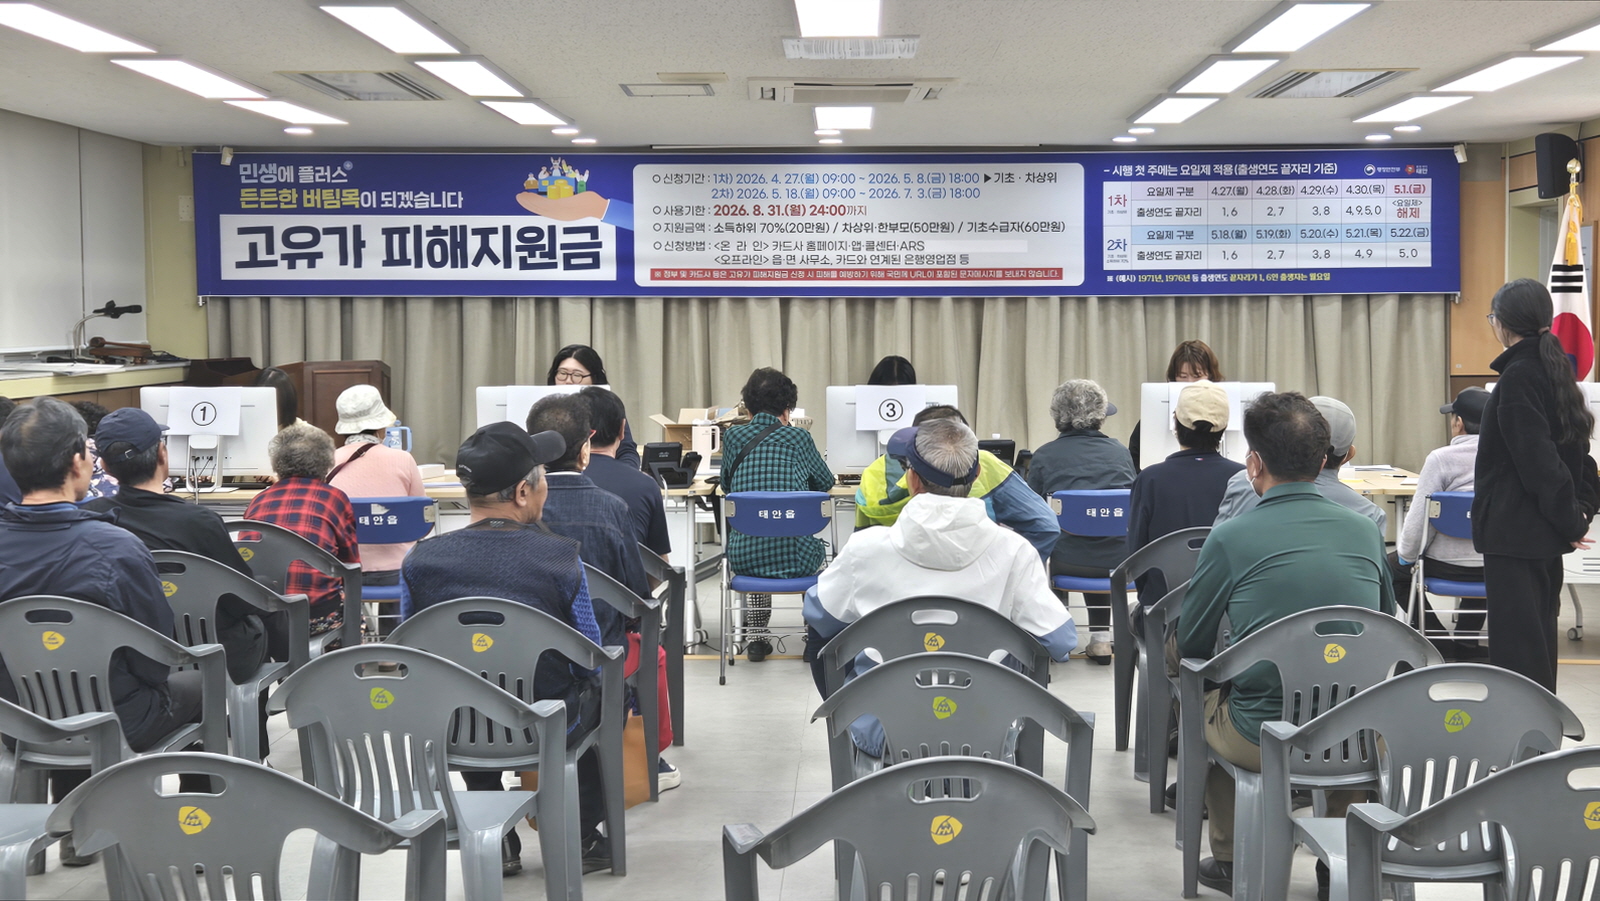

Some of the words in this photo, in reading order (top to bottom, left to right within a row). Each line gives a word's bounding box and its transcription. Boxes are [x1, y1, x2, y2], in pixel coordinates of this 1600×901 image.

[239, 163, 294, 184] 민생에
[298, 166, 348, 184] 플러스
[1112, 164, 1132, 176] 시행
[1135, 164, 1145, 176] 첫
[1148, 164, 1178, 176] 주에는
[1180, 164, 1210, 176] 요일제
[1280, 163, 1311, 175] 끝자리
[1314, 162, 1338, 175] 기준)
[663, 173, 705, 184] 신청기간
[713, 173, 733, 184] 1차)
[736, 173, 768, 184] 2026.
[772, 173, 782, 184] 4.
[784, 173, 820, 184] 27.(월)
[822, 173, 856, 184] 09:00
[868, 173, 900, 184] 2026.
[904, 173, 914, 184] 5.
[917, 173, 946, 184] 8.(금)
[950, 173, 980, 184] 18:00
[1025, 172, 1057, 184] 차상위
[712, 188, 734, 199] 2차)
[738, 188, 769, 199] 2026.
[772, 188, 782, 199] 5.
[786, 188, 820, 199] 18.(월)
[822, 188, 856, 199] 09:00
[868, 188, 901, 199] 2026.
[904, 188, 912, 199] 7.
[918, 188, 946, 199] 3.(금)
[950, 188, 980, 199] 18:00
[1147, 187, 1174, 196] 요일제
[1176, 187, 1194, 196] 구분
[1211, 186, 1248, 196] 4.27.(월)
[1256, 186, 1296, 196] 4.28.(화)
[1300, 185, 1338, 196] 4.29.(수)
[1346, 184, 1385, 195] 4.30.(목)
[1394, 184, 1426, 194] 5.1.(금)
[240, 188, 298, 209] 든든한
[303, 188, 376, 209] 버팀목이
[381, 190, 463, 208] 되겠습니다
[1108, 194, 1128, 208] 1차
[664, 206, 706, 216] 사용기한
[714, 204, 749, 216] 2026.
[752, 204, 764, 216] 8.
[767, 204, 806, 216] 31.(월)
[810, 204, 868, 216] 24:00까지
[1136, 207, 1172, 217] 출생연도
[1175, 207, 1202, 217] 끝자리
[1396, 208, 1420, 218] 해제
[664, 222, 706, 234] 지원금액
[714, 222, 757, 234] 소득하위
[760, 222, 830, 234] 70%(20만원)
[842, 222, 954, 234] 차상위·한부모(50만원)
[966, 222, 1066, 234] 기초수급자(60만원)
[1300, 228, 1339, 239] 5.20.(수)
[1346, 228, 1382, 238] 5.21.(목)
[1390, 228, 1429, 238] 5.22.(금)
[1147, 230, 1174, 240] 요일제
[1176, 230, 1194, 240] 구분
[1212, 230, 1248, 240] 5.18.(월)
[1256, 229, 1292, 240] 5.19.(화)
[235, 224, 366, 270] 고유가
[382, 224, 602, 270] 피해지원금
[664, 240, 706, 252] 신청방법
[772, 240, 803, 252] 카드사
[1107, 238, 1128, 252] 2차
[714, 254, 769, 265] <오프라인>
[772, 254, 796, 265] 읍·면
[836, 254, 867, 265] 카드와
[870, 254, 902, 265] 연계된
[904, 254, 957, 265] 은행영업점
[960, 254, 970, 265] 등
[1136, 251, 1172, 260] 출생연도
[1175, 251, 1202, 260] 끝자리
